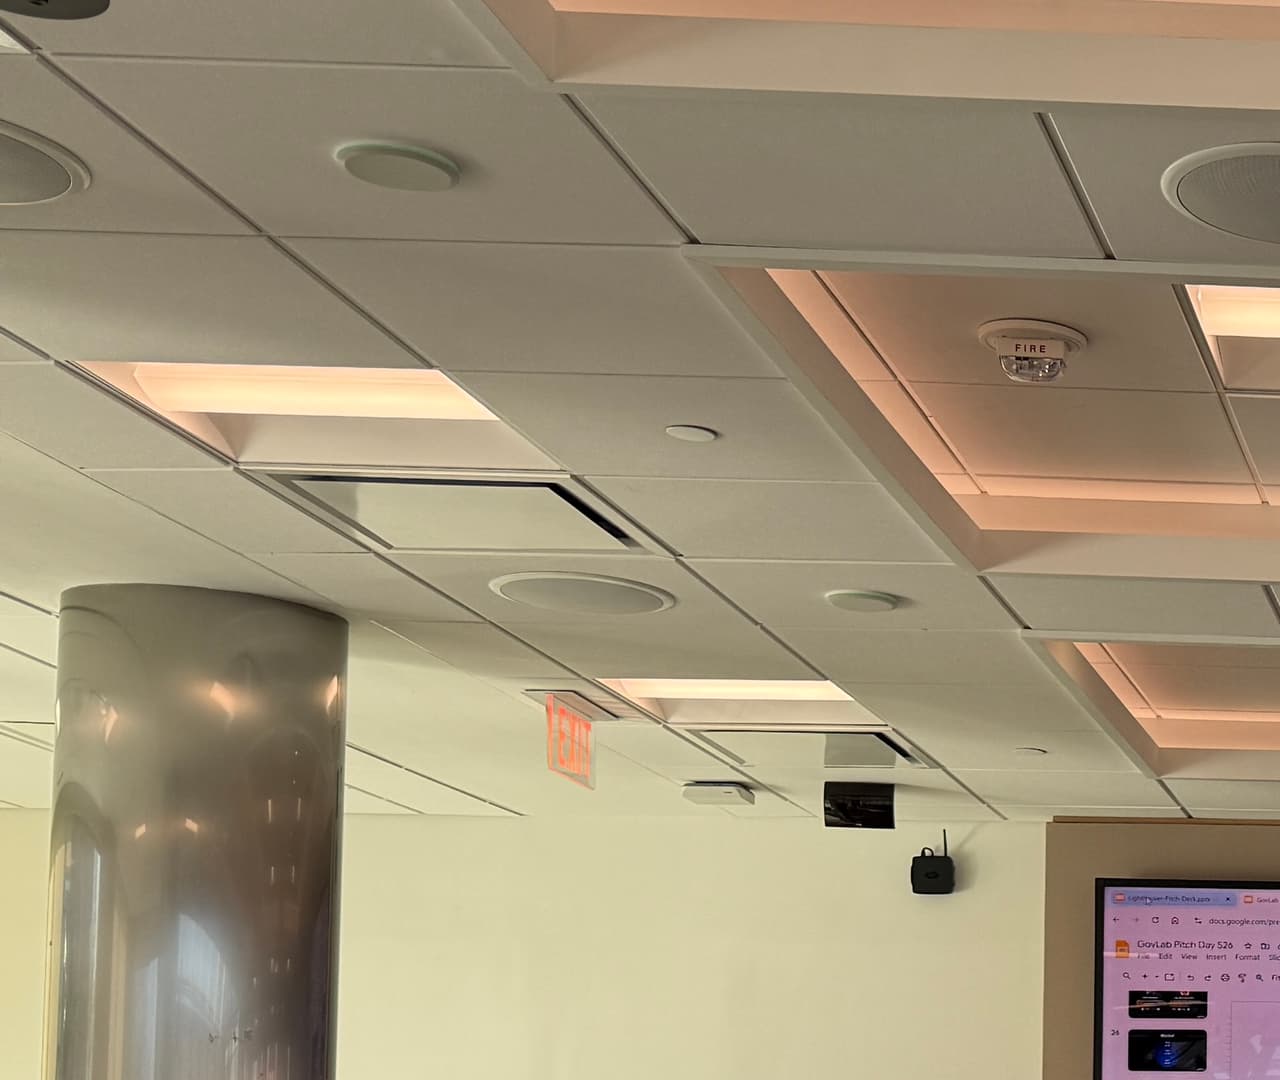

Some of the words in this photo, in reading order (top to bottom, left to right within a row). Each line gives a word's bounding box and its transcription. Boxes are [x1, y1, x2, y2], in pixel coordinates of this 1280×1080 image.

[1015, 343, 1047, 353] FIRE
[557, 705, 592, 778] EXIT
[1137, 940, 1173, 949] GovLab
[1174, 940, 1197, 949] Pitch
[1198, 941, 1216, 950] Day
[1206, 953, 1228, 961] Insert
